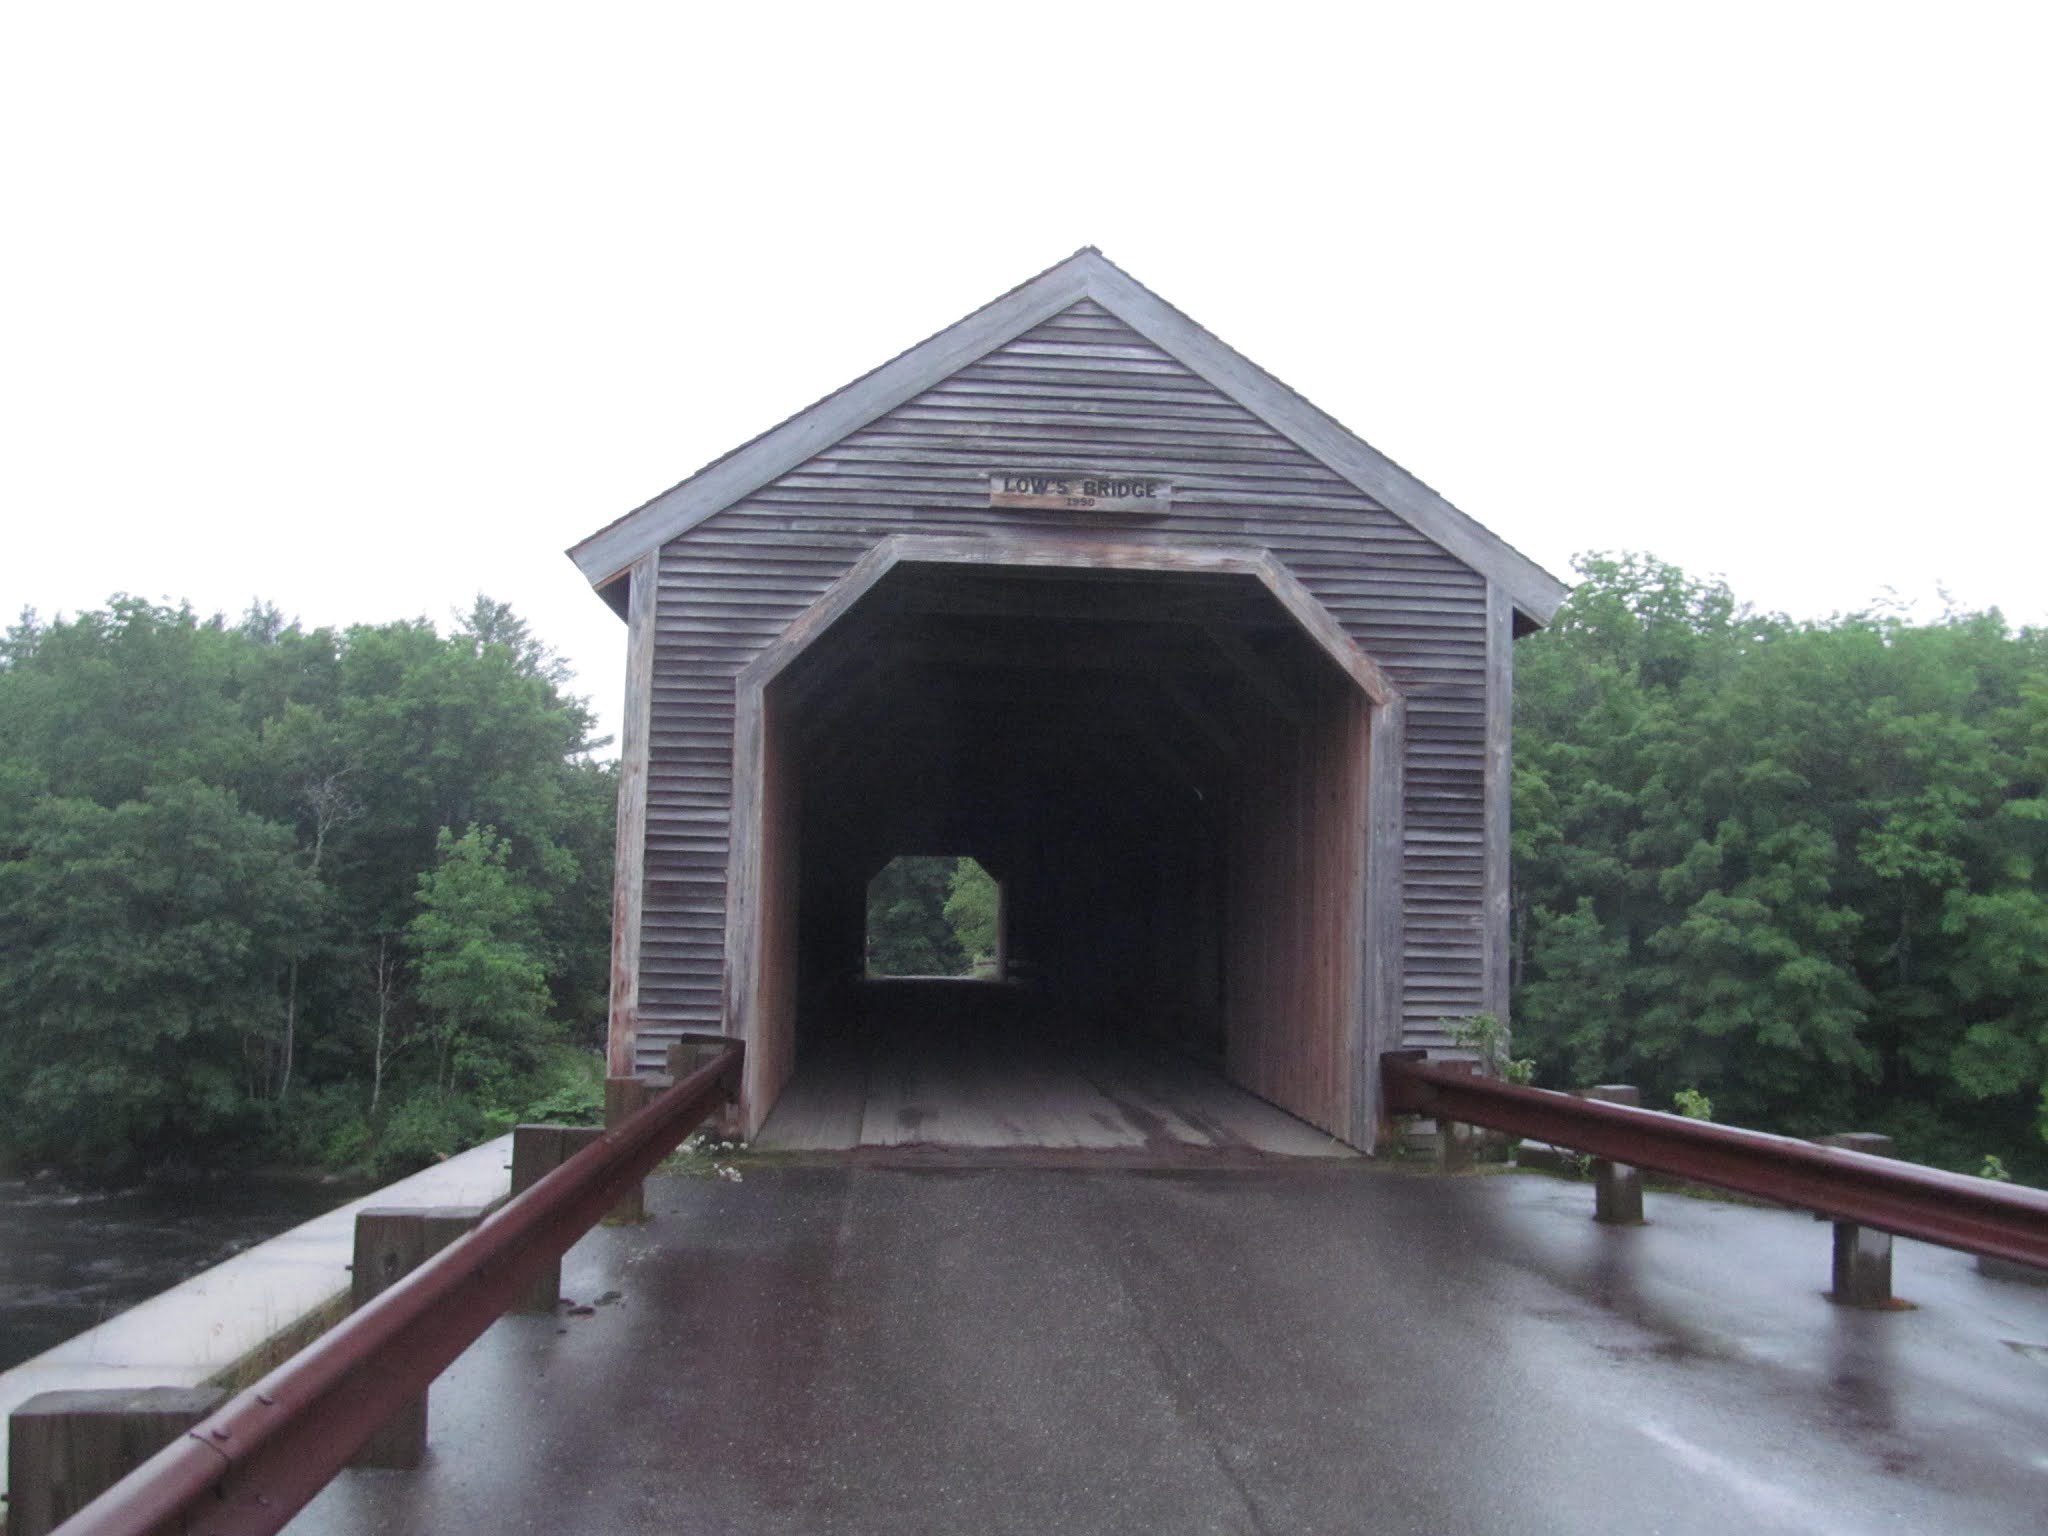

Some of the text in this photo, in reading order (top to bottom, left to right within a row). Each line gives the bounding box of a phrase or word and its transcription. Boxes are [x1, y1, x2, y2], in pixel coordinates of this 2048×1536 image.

[1004, 477, 1156, 498] LOW'S BRIDGE
[1066, 497, 1095, 507] 1990
